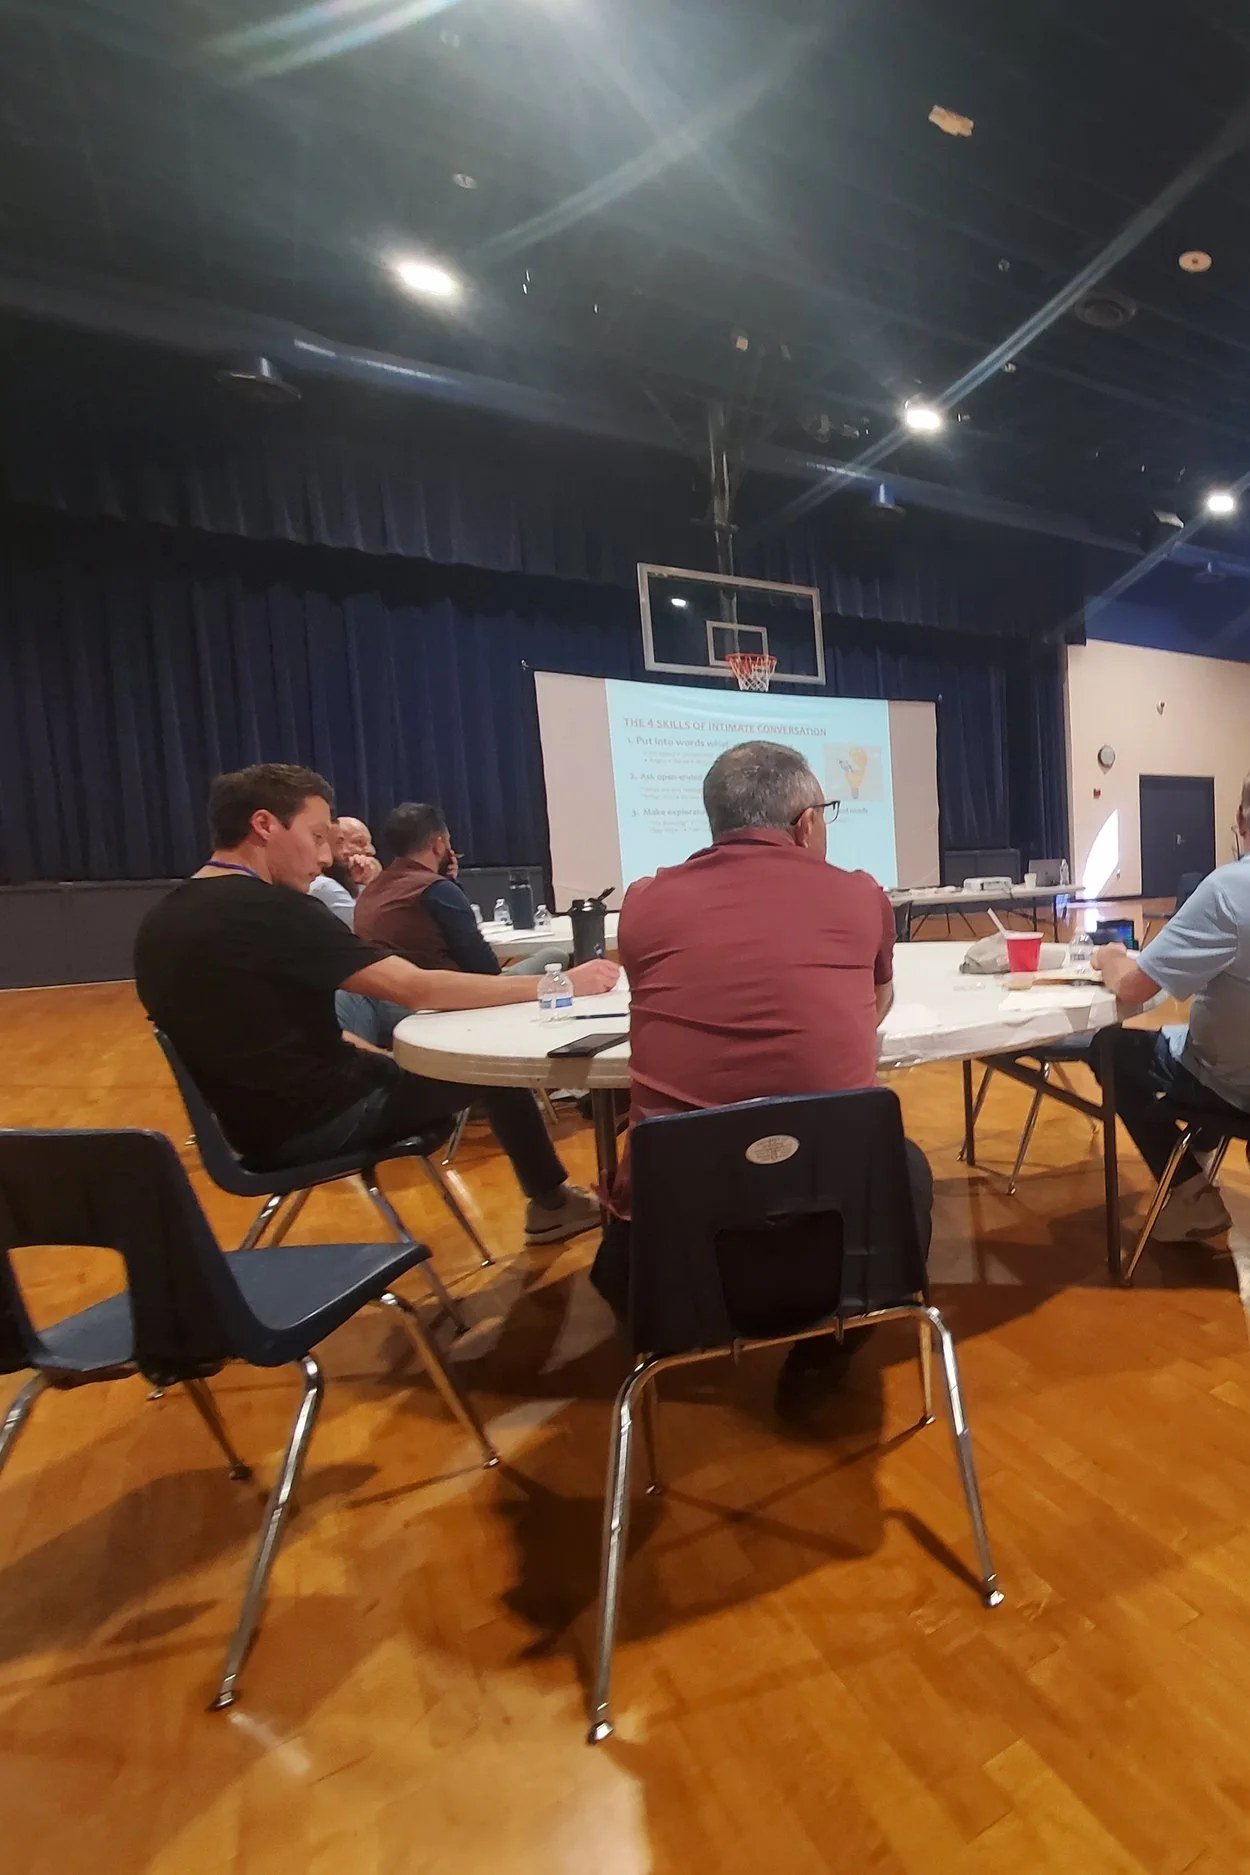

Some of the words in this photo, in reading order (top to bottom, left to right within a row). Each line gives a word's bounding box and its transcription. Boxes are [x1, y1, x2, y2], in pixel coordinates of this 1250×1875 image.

[624, 717, 645, 728] THE
[647, 717, 655, 728] 4
[656, 719, 690, 730] SKILLS
[692, 721, 705, 731] OF
[708, 722, 754, 734] INTIMATE
[757, 723, 827, 736] CONVERSATION
[636, 736, 653, 746] Put
[676, 738, 705, 747] words
